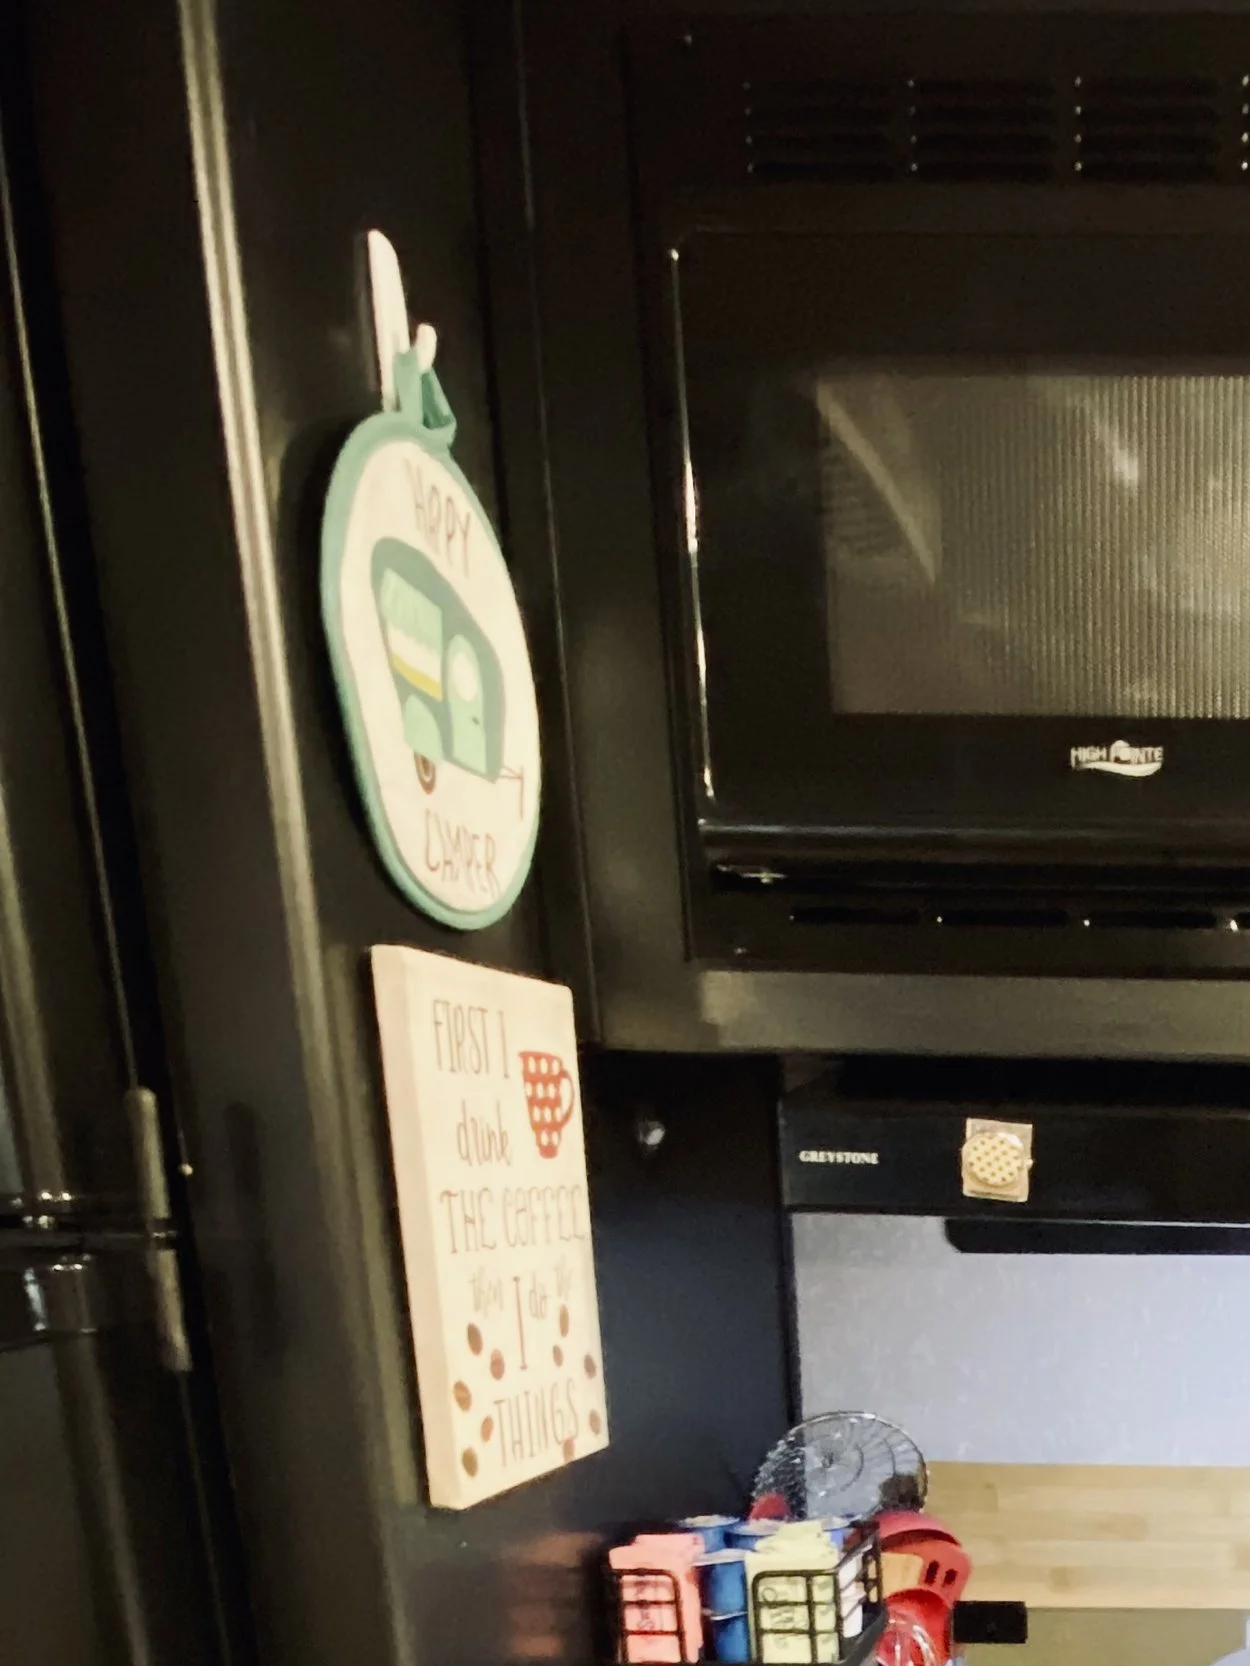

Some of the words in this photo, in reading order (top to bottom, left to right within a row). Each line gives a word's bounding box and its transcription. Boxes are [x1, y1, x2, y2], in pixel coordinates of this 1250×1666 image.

[402, 457, 471, 579] HAPPY
[424, 807, 501, 900] CAMPER
[433, 998, 489, 1074] FIRST
[498, 1010, 509, 1078] I
[456, 1099, 511, 1167] drink
[799, 1150, 880, 1165] GREYSTONE
[440, 1187, 497, 1254] THE
[503, 1183, 586, 1248] COFFEE
[513, 1276, 528, 1371] I
[493, 1377, 580, 1468] THINGS
